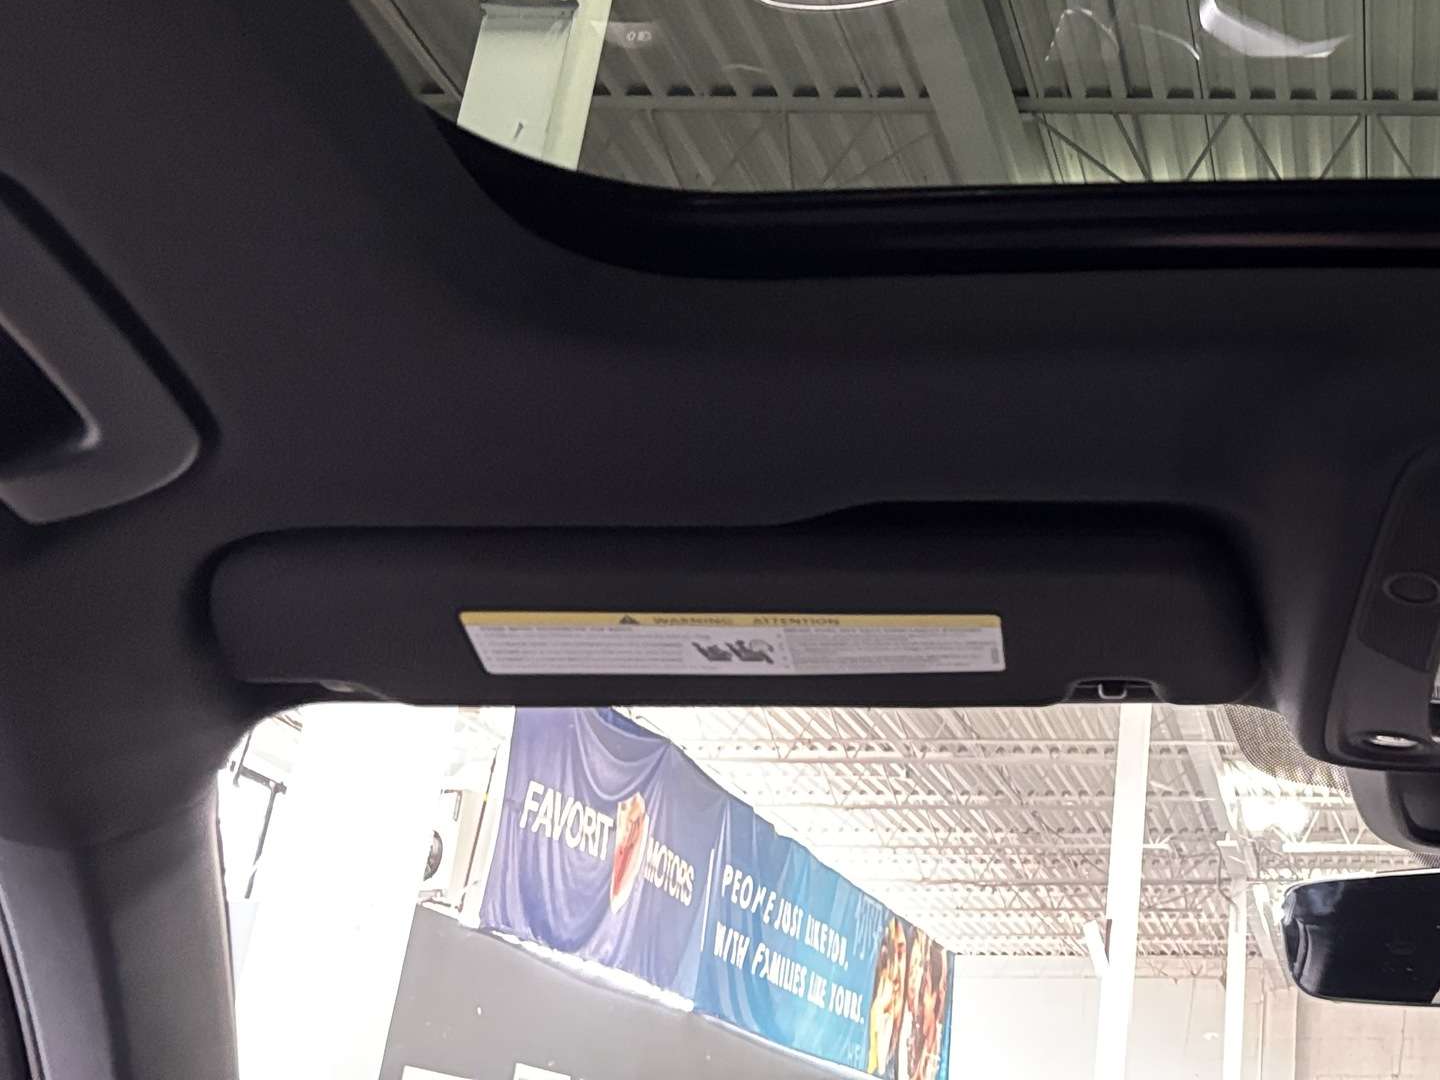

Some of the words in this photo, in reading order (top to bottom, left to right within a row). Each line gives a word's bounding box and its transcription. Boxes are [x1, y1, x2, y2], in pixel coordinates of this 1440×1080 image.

[520, 780, 614, 861] FAVORIT
[644, 836, 695, 907] MOTORS
[713, 921, 750, 970] WITH
[751, 942, 808, 999] FAMILIES
